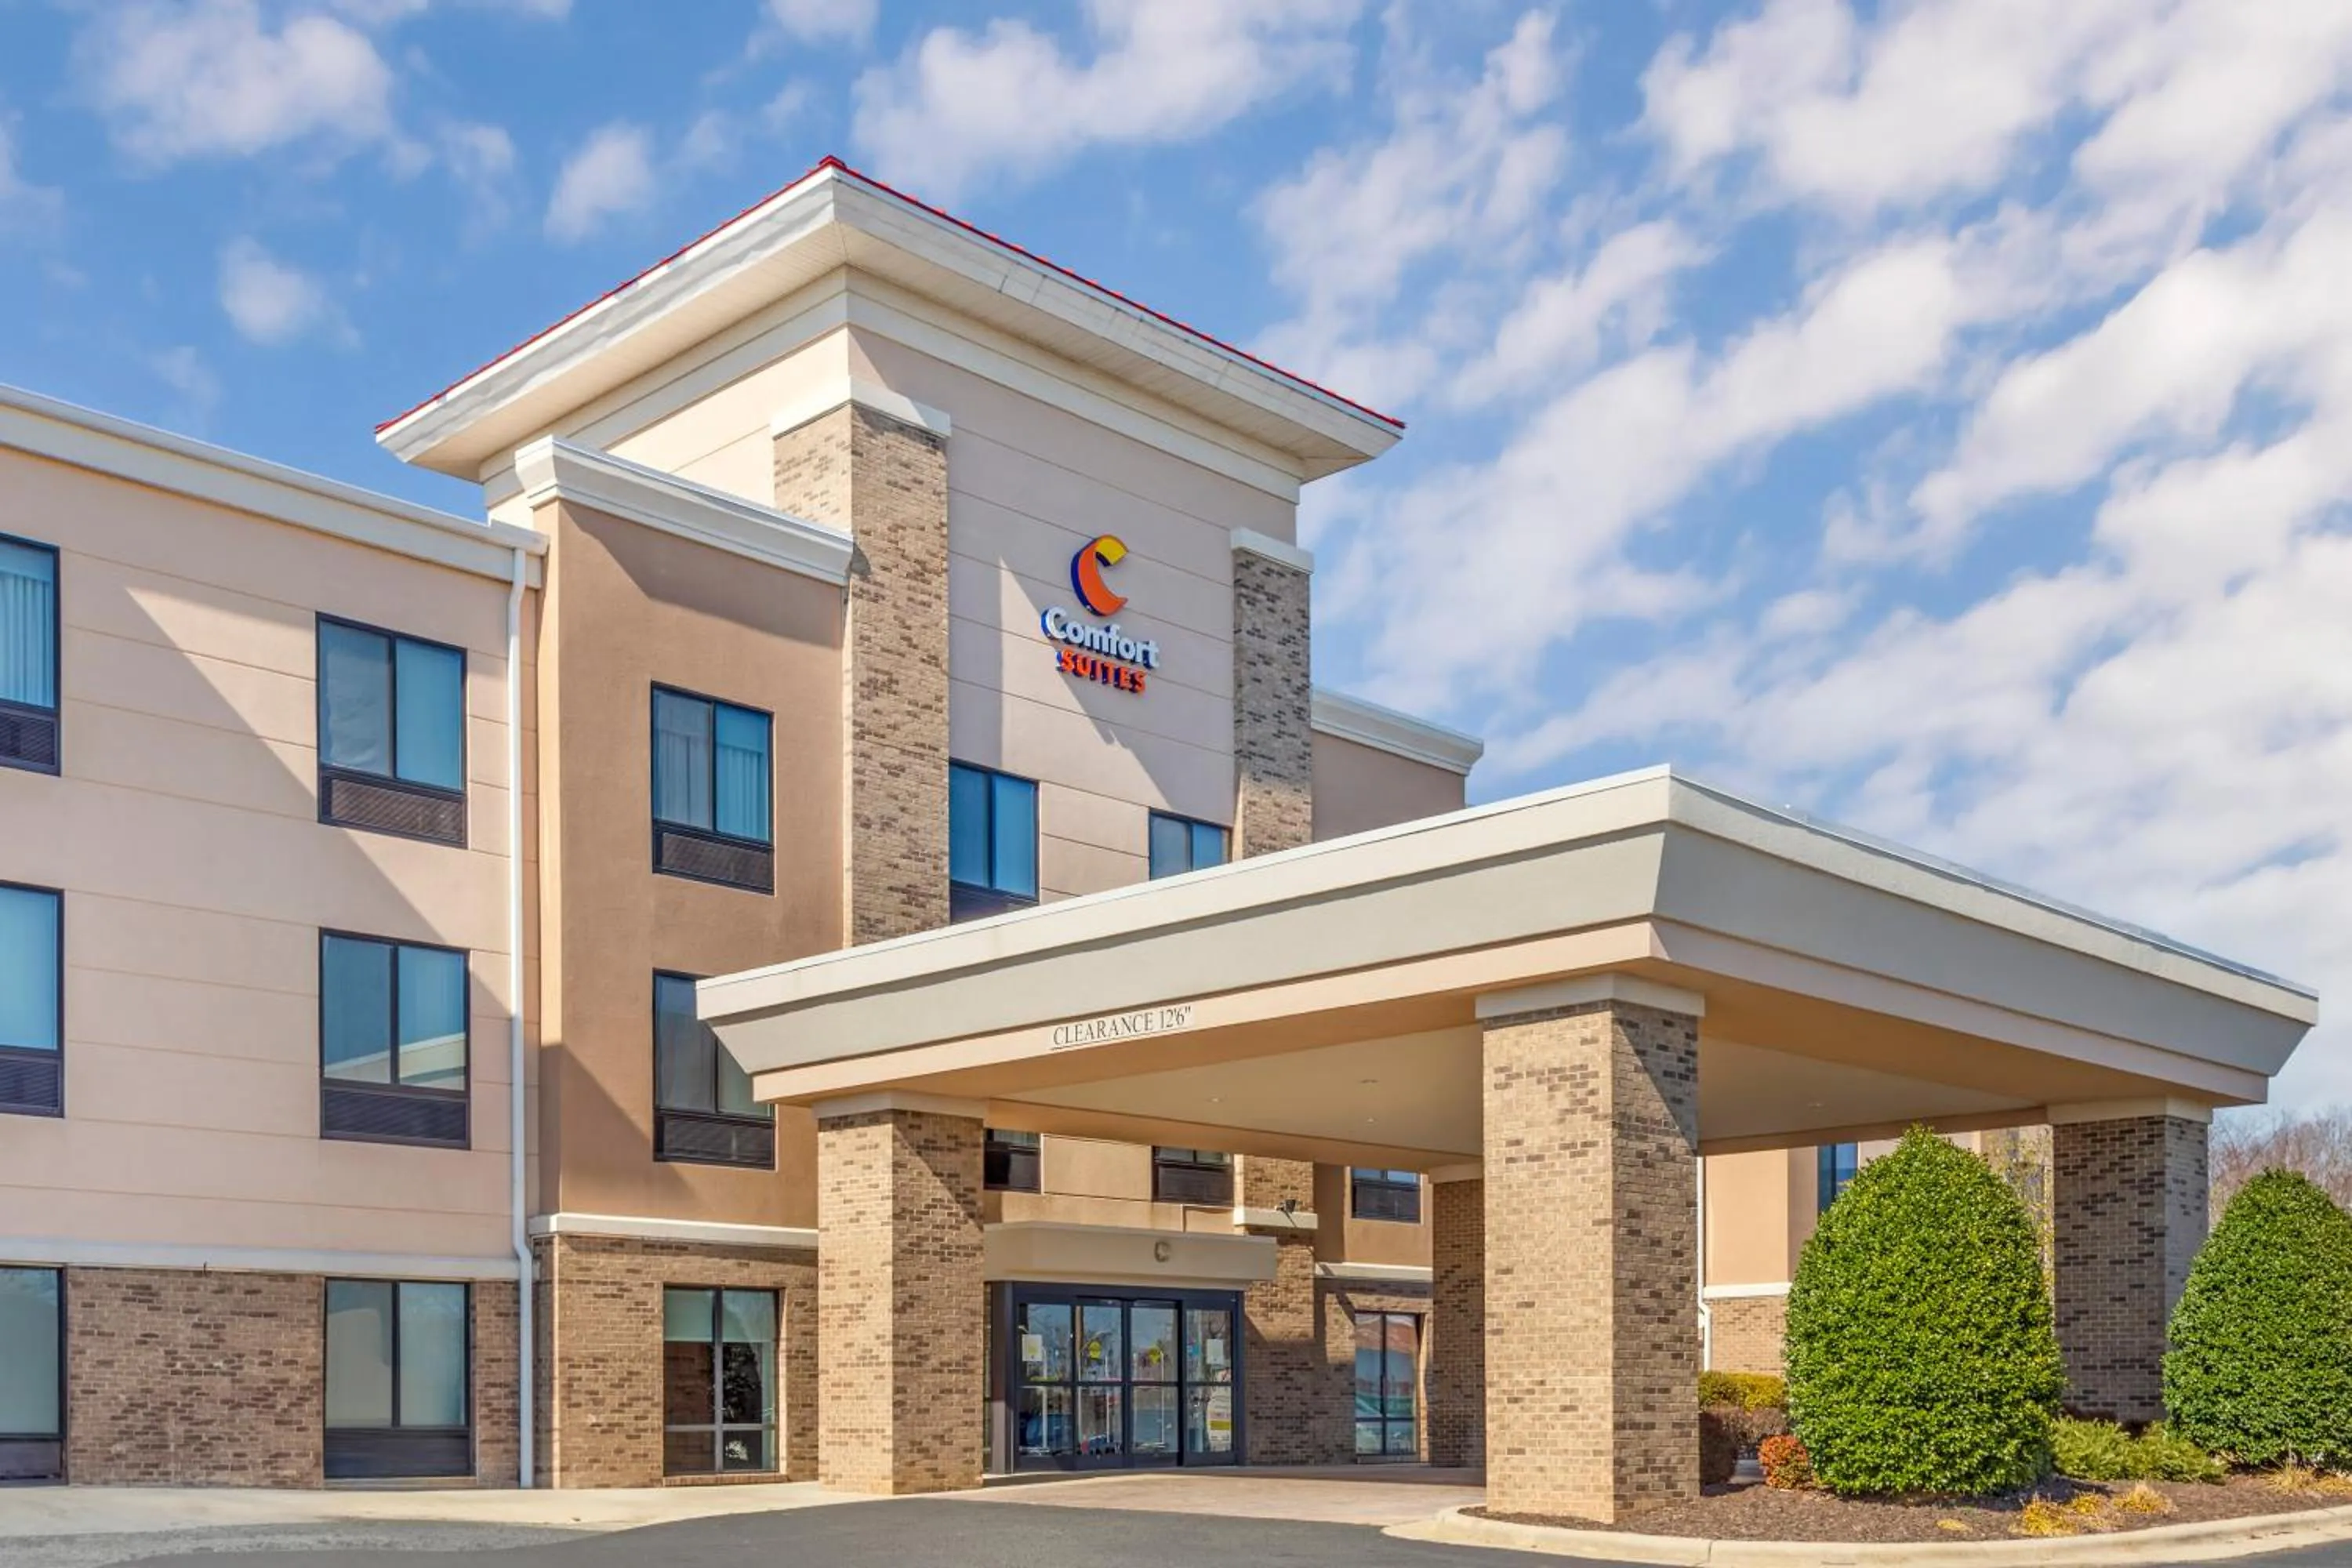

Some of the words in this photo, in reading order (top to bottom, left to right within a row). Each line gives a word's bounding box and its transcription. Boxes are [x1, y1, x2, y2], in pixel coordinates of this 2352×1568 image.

[1041, 607, 1160, 669] Comfort
[1056, 646, 1147, 694] SUITES
[1053, 1012, 1153, 1045] CLEARANCE
[1160, 1005, 1191, 1029] 12'6"
